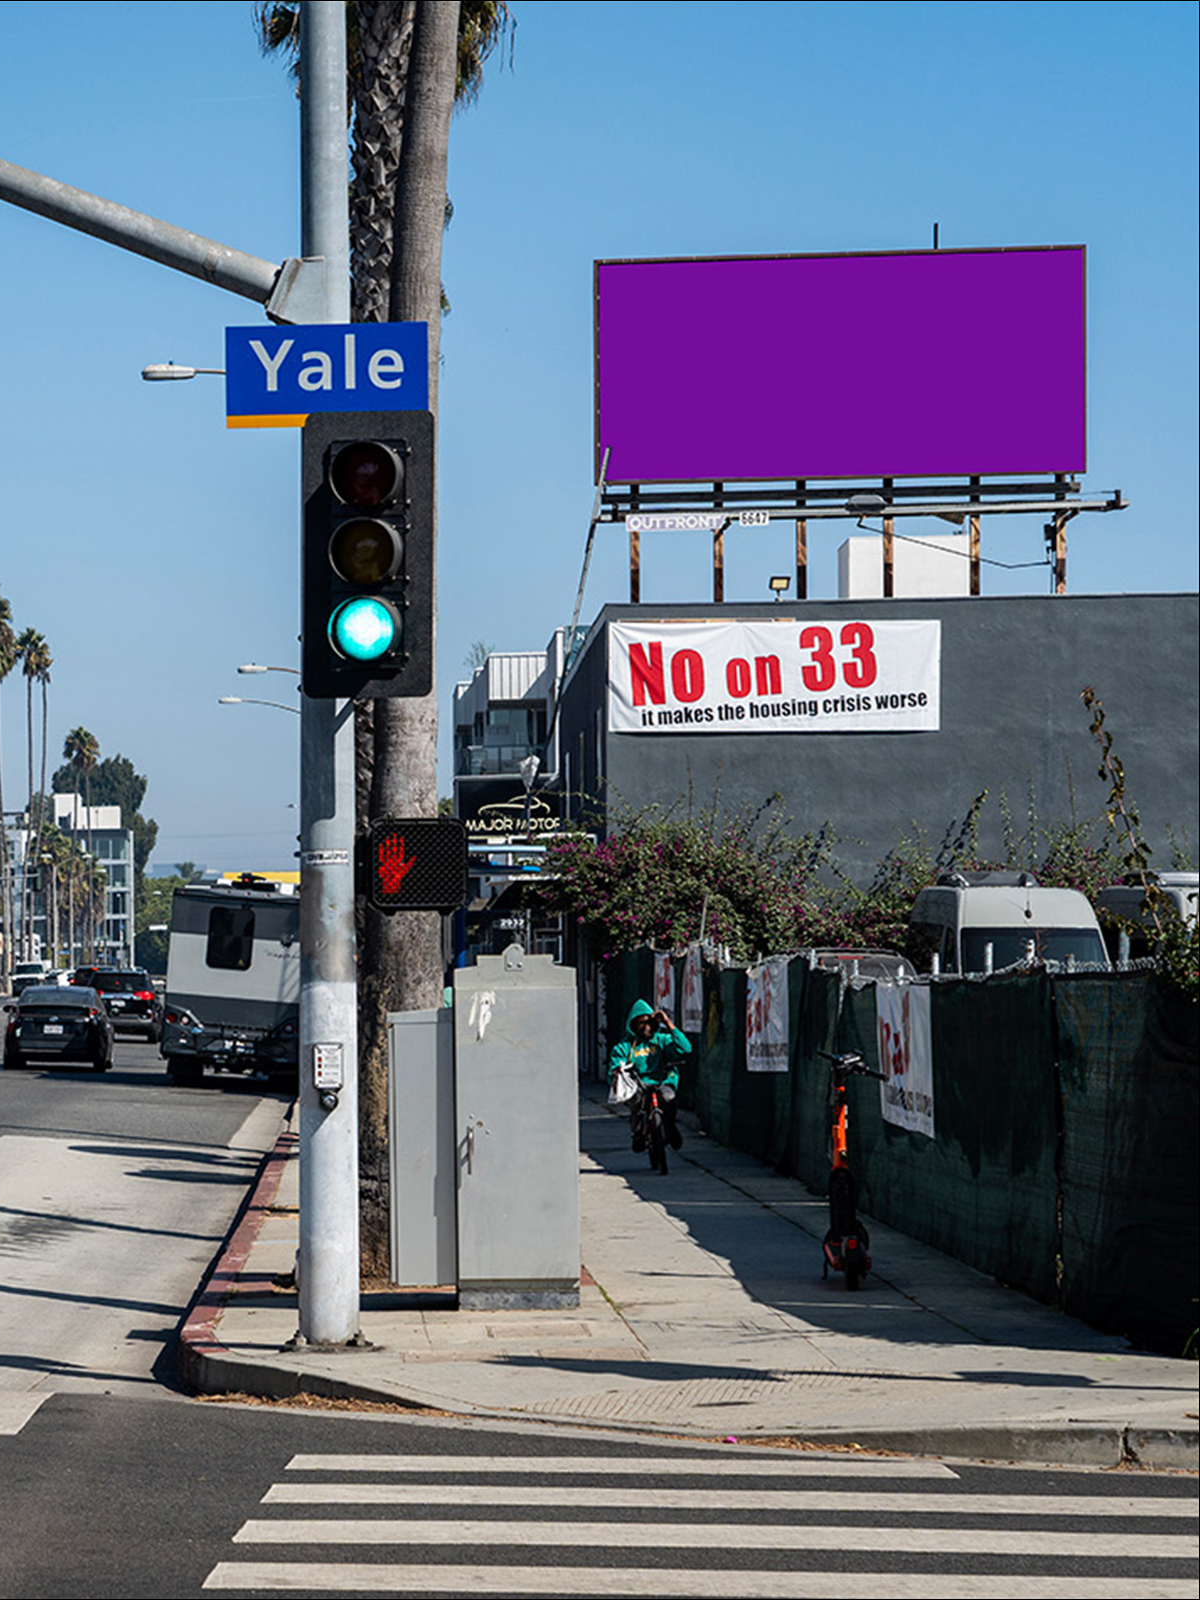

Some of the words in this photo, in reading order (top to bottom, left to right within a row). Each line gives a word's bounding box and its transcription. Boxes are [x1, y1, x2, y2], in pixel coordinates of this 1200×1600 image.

[248, 333, 405, 392] Yale
[726, 654, 783, 699] on
[799, 622, 878, 692] 33
[641, 708, 654, 727] it
[658, 705, 714, 725] makes
[718, 702, 746, 721] the
[749, 697, 819, 719] housing
[823, 694, 872, 713] crisis
[875, 691, 928, 710] worse
[465, 818, 514, 831] MAJOR
